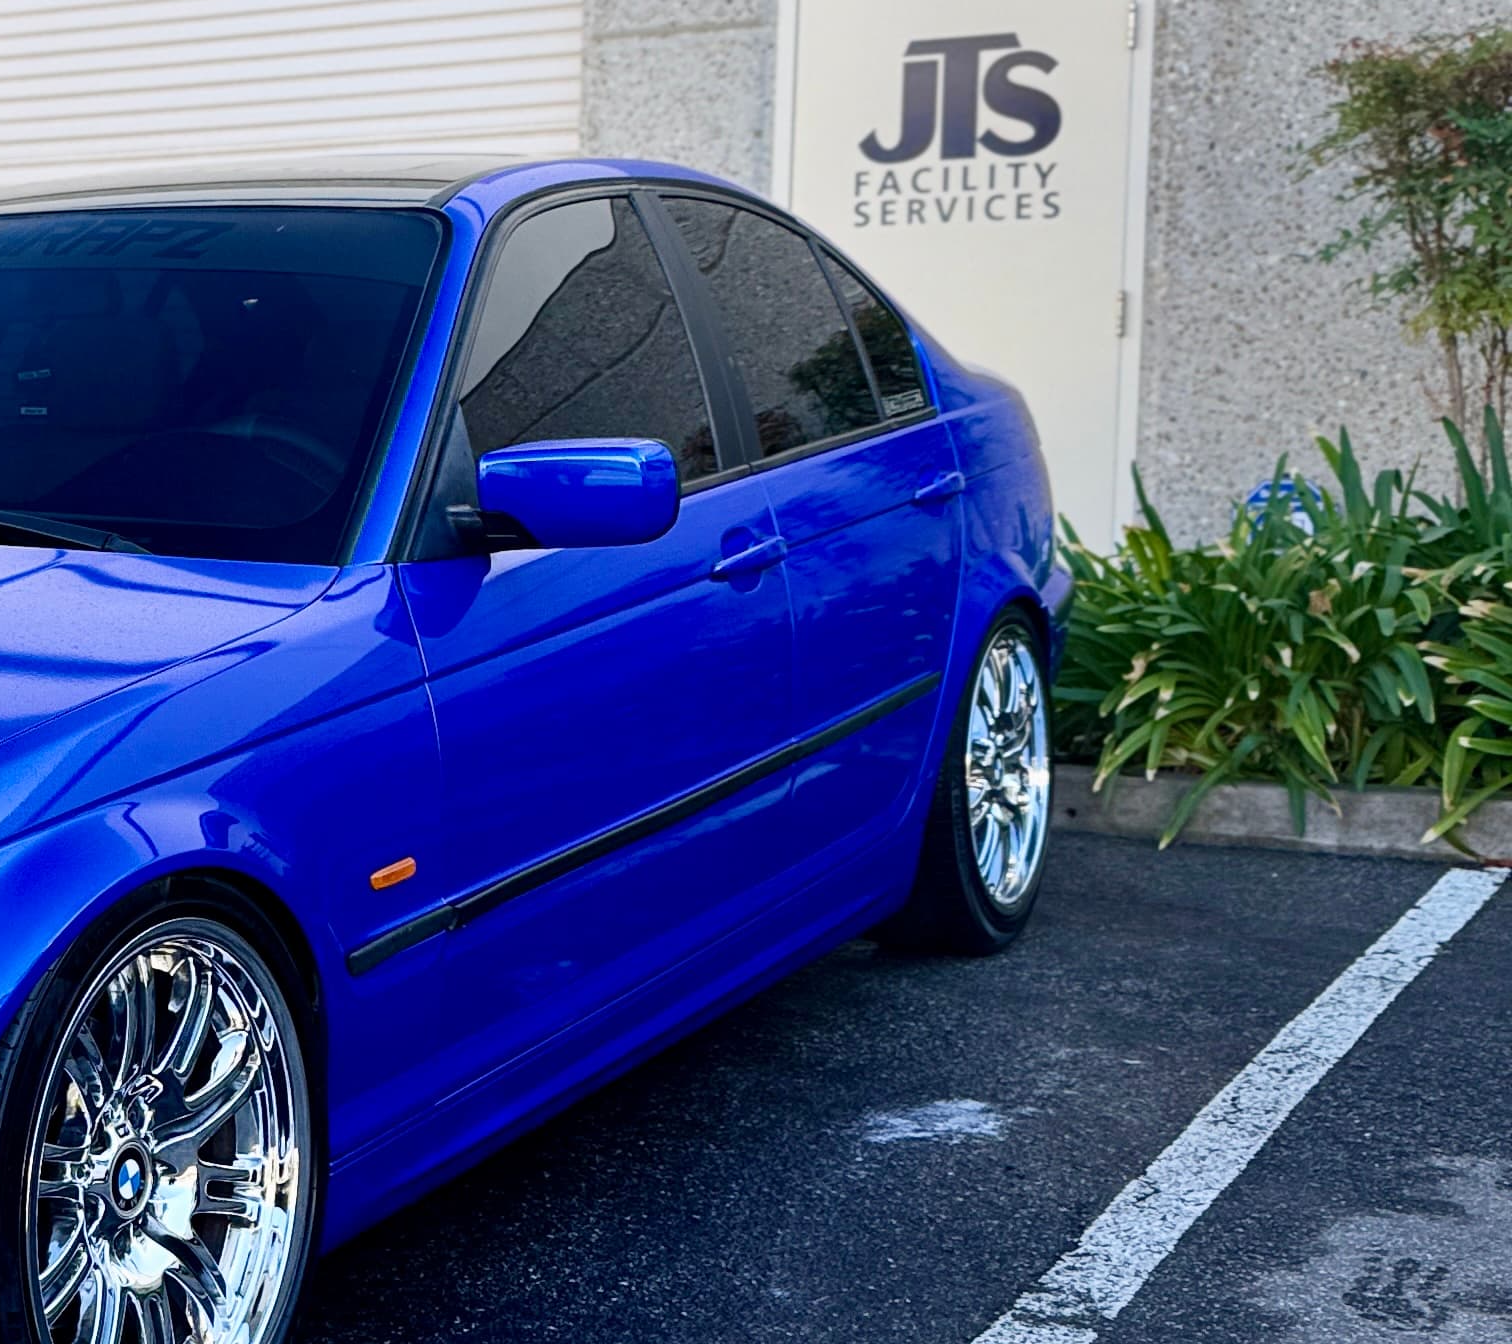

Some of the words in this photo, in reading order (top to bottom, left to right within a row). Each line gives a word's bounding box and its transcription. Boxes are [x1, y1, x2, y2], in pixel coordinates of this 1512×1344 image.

[858, 32, 1062, 164] JTS
[854, 162, 1058, 197] FACILITY
[854, 192, 1061, 227] SERVICES
